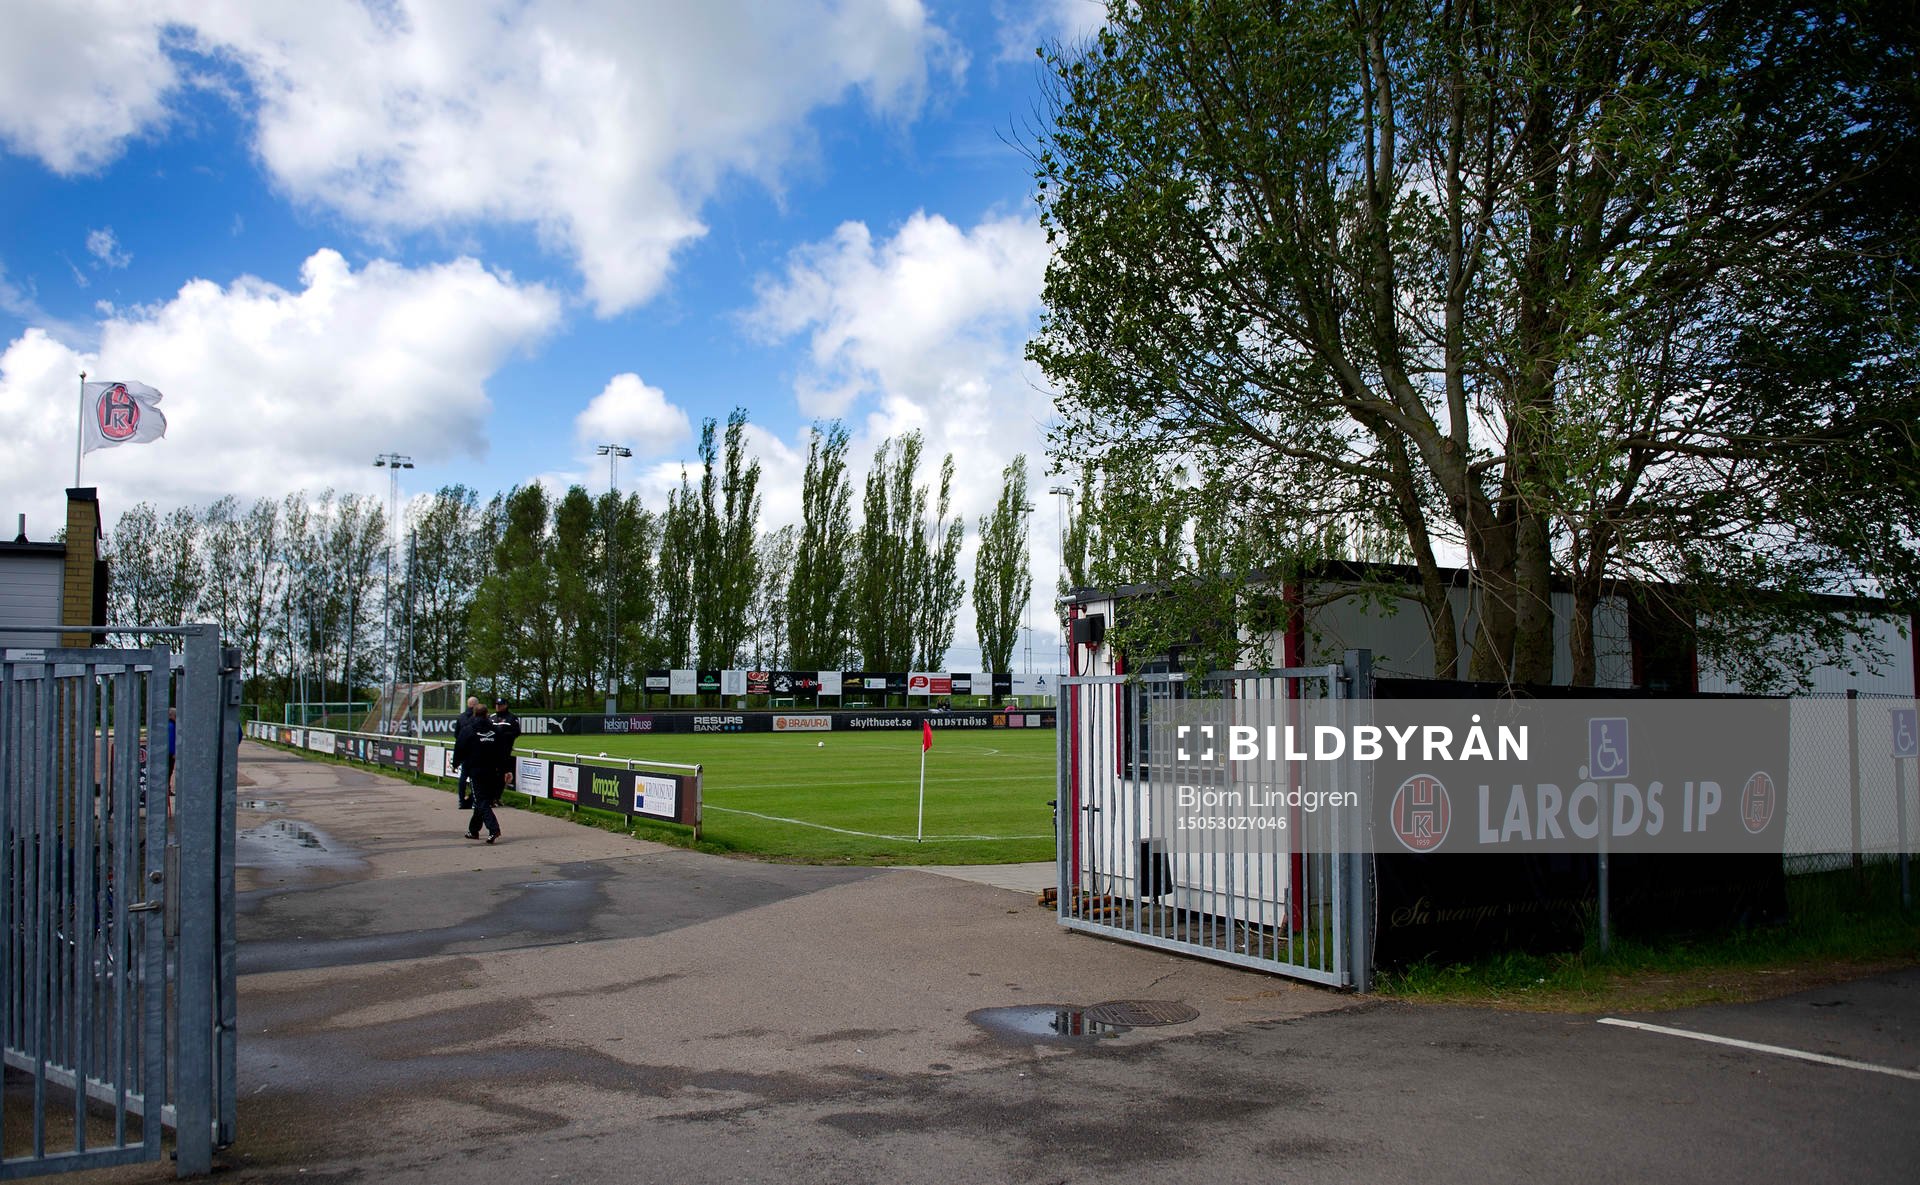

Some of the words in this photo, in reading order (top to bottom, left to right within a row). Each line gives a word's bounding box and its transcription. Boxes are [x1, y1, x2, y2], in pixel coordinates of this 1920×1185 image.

[518, 717, 547, 733] MA
[604, 717, 629, 732] helsing
[630, 717, 652, 730] House
[693, 716, 744, 725] RESURS
[788, 718, 829, 728] BRAVURA
[850, 717, 912, 729] skylthuset.se
[1683, 781, 1722, 833] IP
